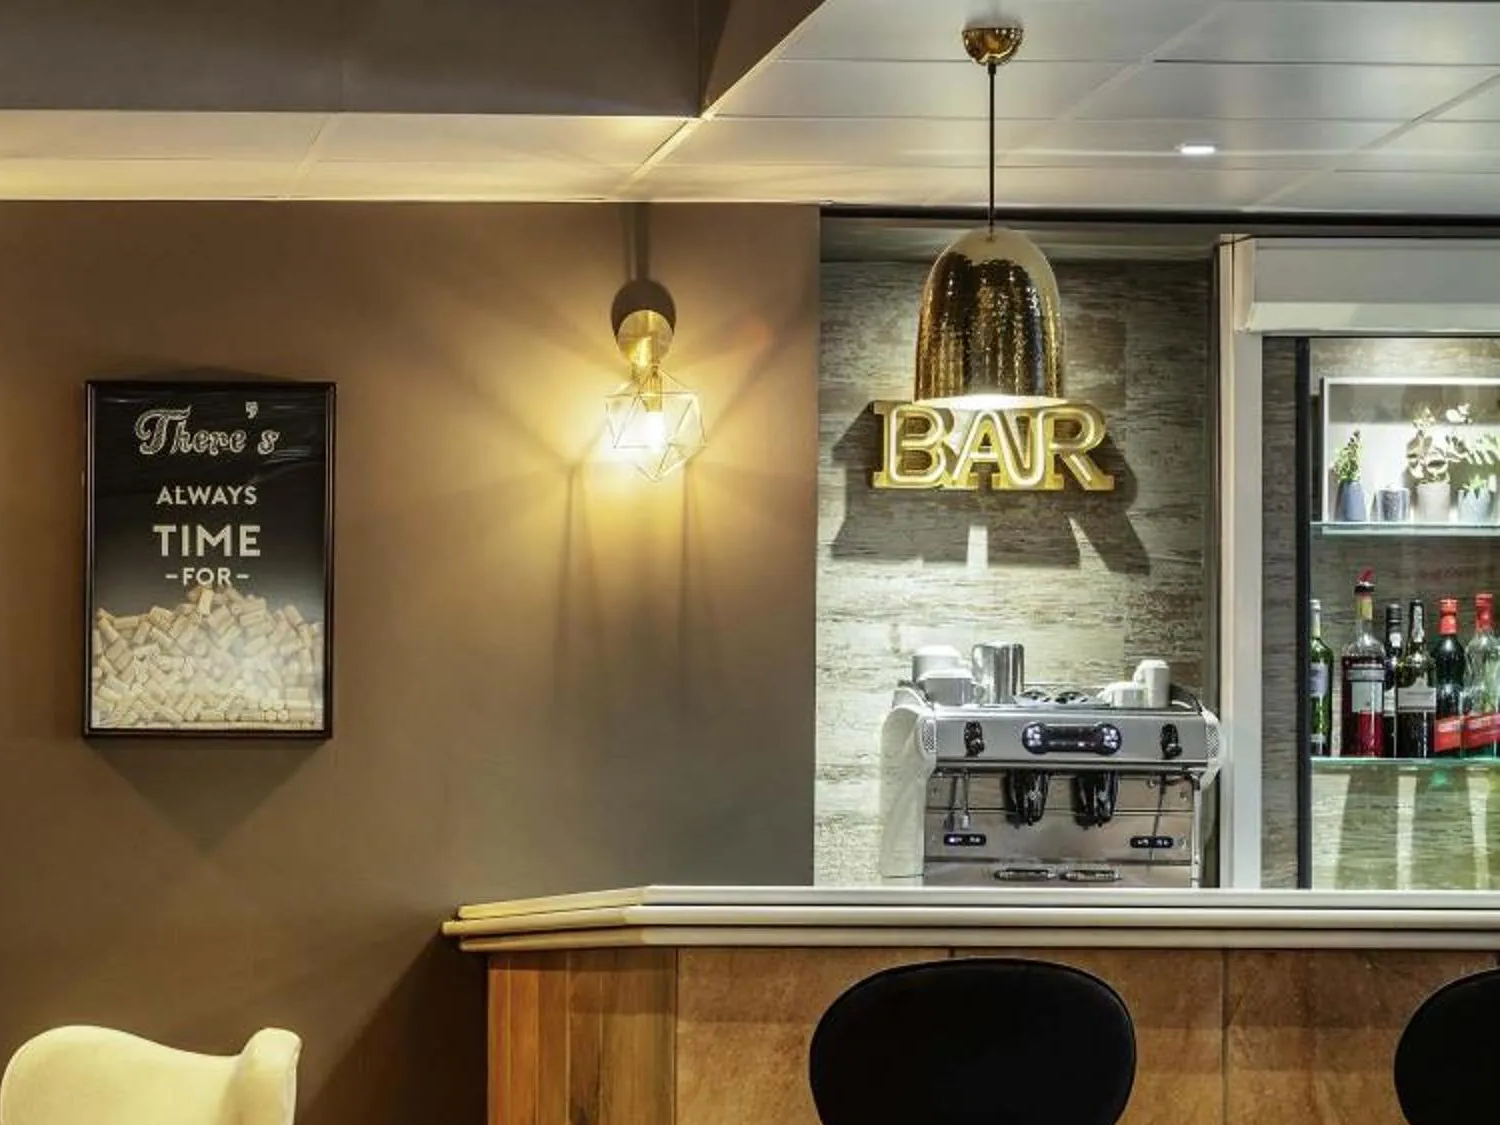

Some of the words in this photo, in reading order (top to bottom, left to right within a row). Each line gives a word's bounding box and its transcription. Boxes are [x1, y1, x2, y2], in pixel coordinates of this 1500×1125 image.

[135, 401, 281, 455] There's
[873, 400, 1115, 490] BAR
[156, 485, 258, 505] ALWAYS
[153, 524, 261, 557] TIME
